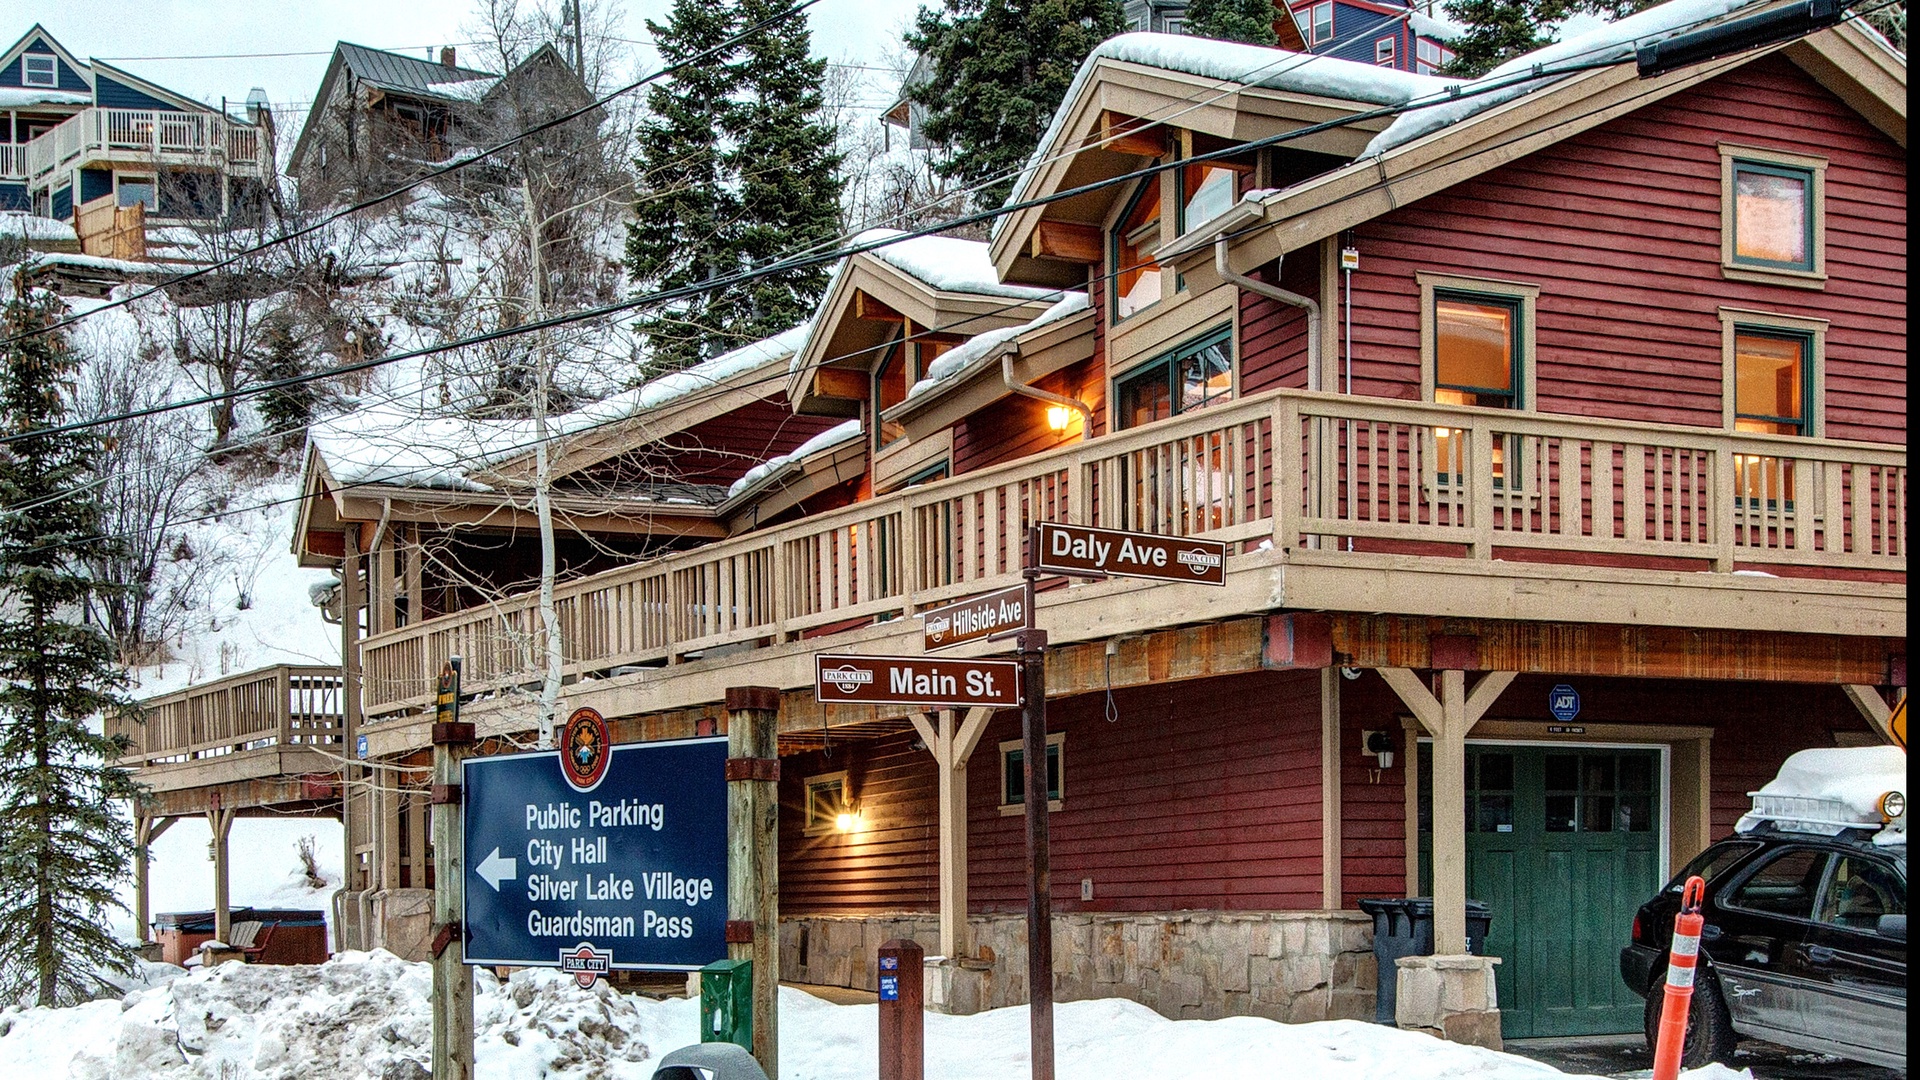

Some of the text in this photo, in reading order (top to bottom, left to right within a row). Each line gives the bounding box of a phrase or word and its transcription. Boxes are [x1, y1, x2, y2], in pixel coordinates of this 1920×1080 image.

[1052, 530, 1167, 567] Daly Ave
[953, 599, 1022, 637] Hillside Ave
[826, 672, 869, 680] PARK CITY
[890, 667, 1001, 697] Main St.
[1554, 696, 1575, 709] ADT
[1368, 769, 1381, 785] 17
[526, 798, 664, 831] Public Parking
[527, 836, 607, 870] City Hall
[527, 872, 713, 906] Silver Lake Village
[527, 909, 693, 938] Guardsman Pass
[566, 958, 605, 970] PARK CITY
